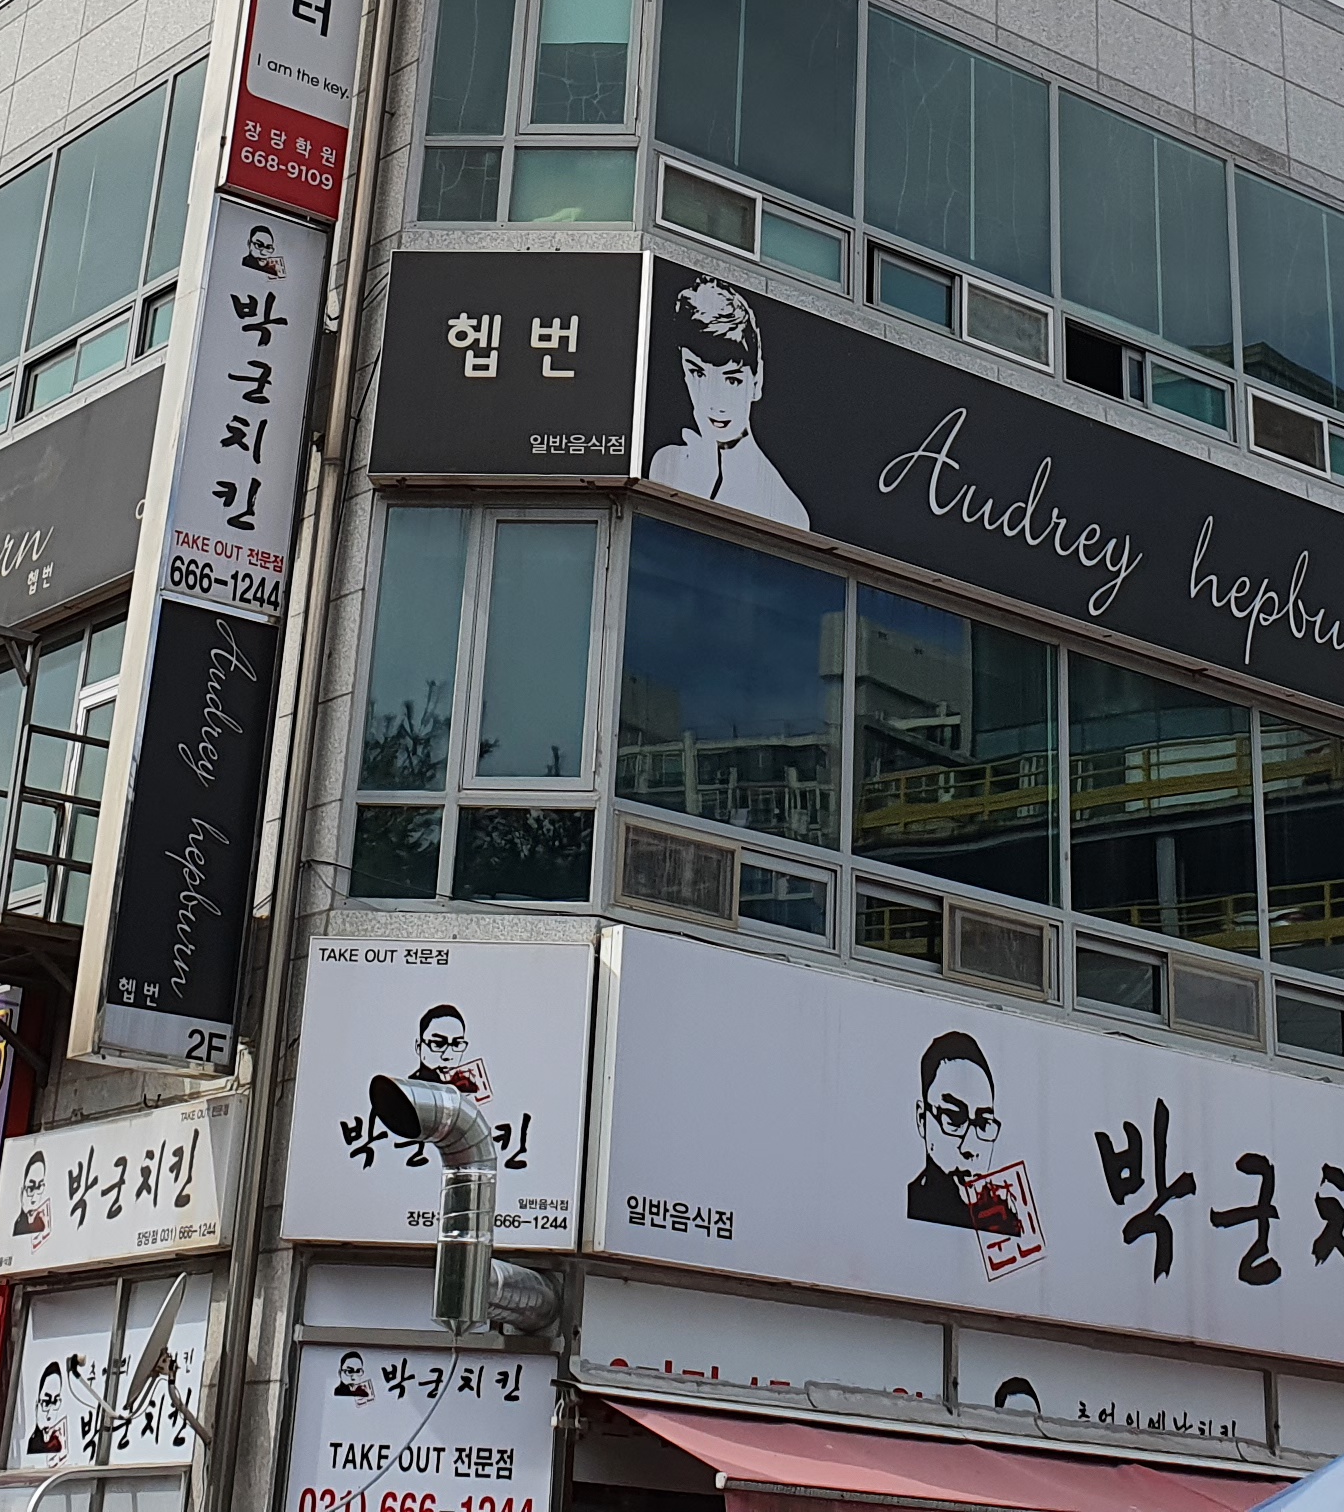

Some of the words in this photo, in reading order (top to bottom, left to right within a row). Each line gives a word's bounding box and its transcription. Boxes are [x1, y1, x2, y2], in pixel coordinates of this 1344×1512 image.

[267, 61, 292, 80] am
[295, 64, 320, 89] the
[322, 72, 350, 101] key.
[243, 119, 338, 169] 장당학원
[240, 145, 335, 191] 668-9109
[446, 311, 580, 380] 헵번
[212, 290, 290, 532] 박군치킨
[529, 431, 627, 458] 일반음식점
[878, 406, 1144, 617] Audrey
[174, 529, 213, 555] TAKE
[214, 537, 244, 563] OUT
[246, 546, 285, 575] 전문점
[169, 554, 284, 613] 666-1244
[178, 616, 258, 789] Audrey
[162, 816, 232, 1002] hepburn
[318, 947, 360, 963] TAKE
[364, 948, 399, 964] OUT
[403, 948, 451, 966] 전문점
[117, 975, 161, 1008] 헵번
[185, 1026, 227, 1064] 2F
[67, 1127, 200, 1231] 박군치킨
[493, 1213, 569, 1231] 666-1244
[517, 1197, 570, 1211] 일반음식점
[625, 1195, 735, 1241] 일반음식점
[159, 1226, 178, 1244] 031)
[178, 1221, 217, 1241] 666-1244
[380, 1357, 523, 1402] 박군치킨
[329, 1442, 391, 1471] TAKE
[397, 1445, 446, 1474] OUT
[453, 1446, 515, 1480] 전문점
